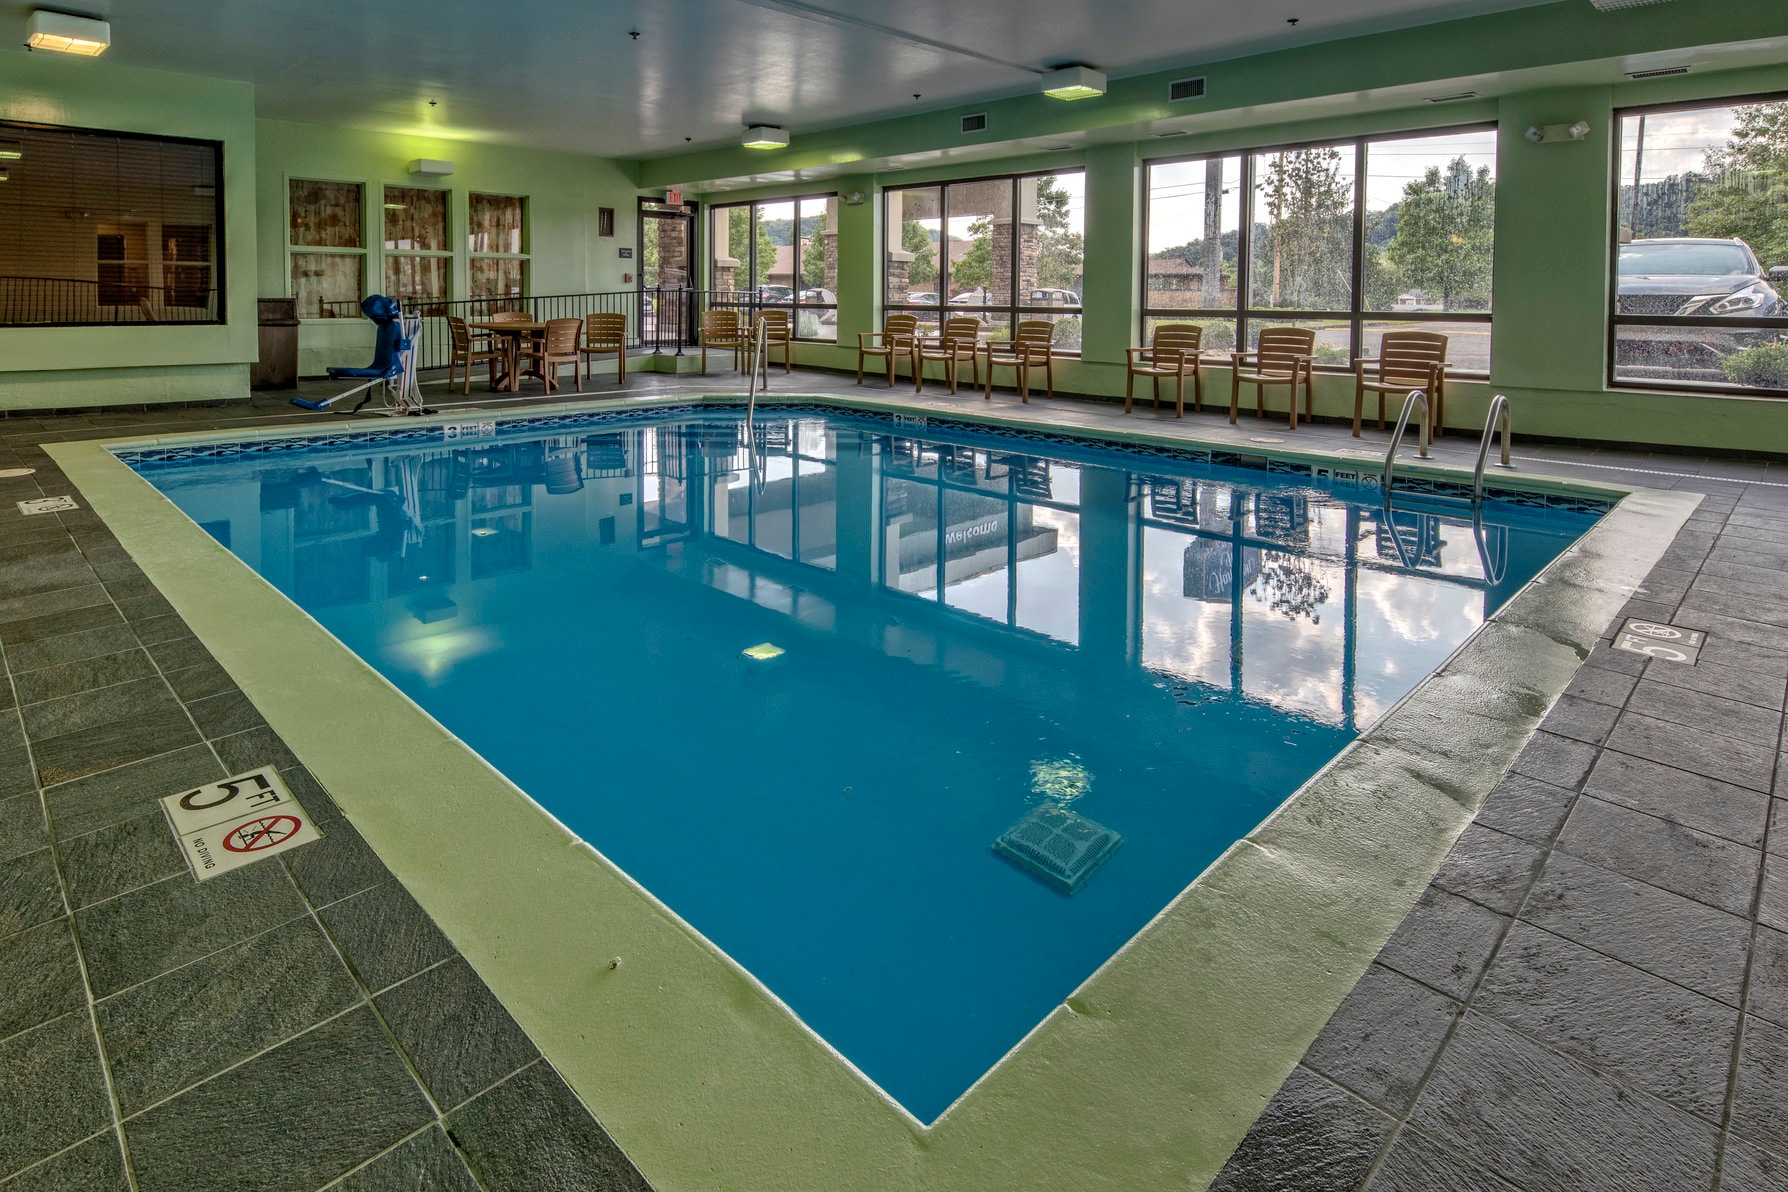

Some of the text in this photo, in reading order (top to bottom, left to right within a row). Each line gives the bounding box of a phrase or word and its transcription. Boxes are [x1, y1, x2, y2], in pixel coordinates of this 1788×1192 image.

[669, 192, 682, 203] EXIT
[1335, 471, 1357, 480] FEET
[1620, 634, 1687, 661] 5 FT
[179, 773, 281, 811] 5 FT
[192, 837, 216, 870] NO DIVING
